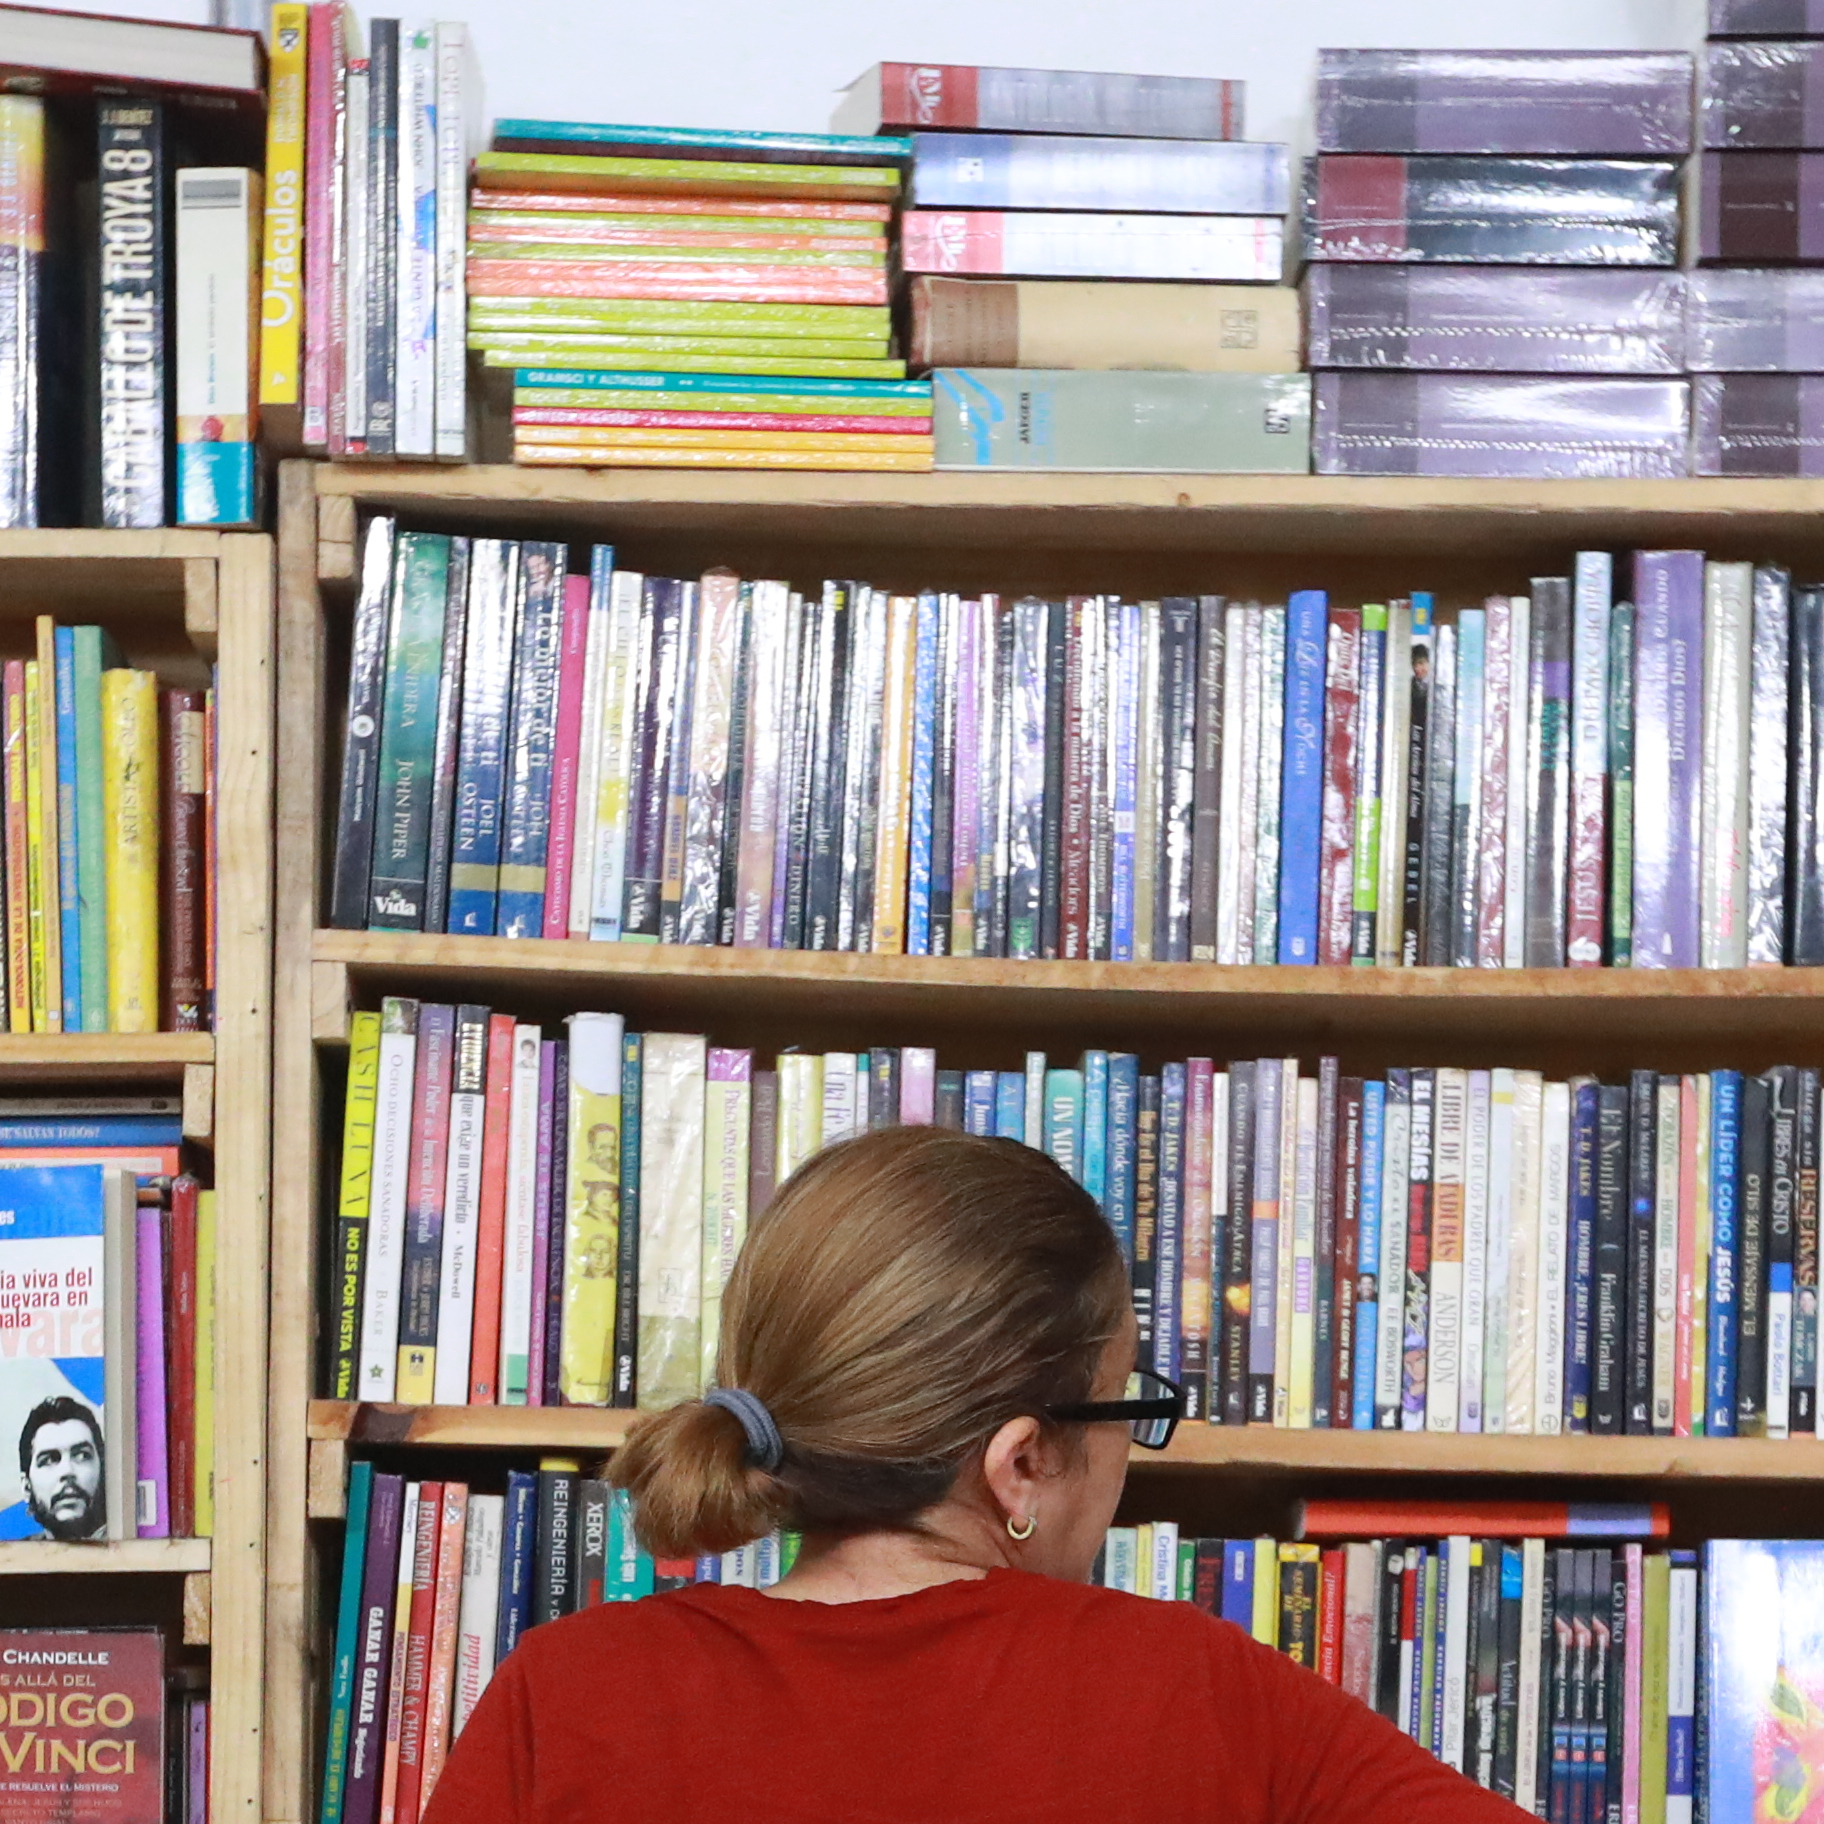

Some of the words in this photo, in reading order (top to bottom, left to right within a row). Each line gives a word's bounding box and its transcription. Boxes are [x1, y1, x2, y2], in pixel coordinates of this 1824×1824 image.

[262, 171, 295, 328] Oráculos
[1412, 1080, 1431, 1102] EL
[1411, 1105, 1434, 1179] MESÍAS
[1718, 1120, 1737, 1177] LÍDER
[1717, 1183, 1734, 1241] COMO
[1746, 1174, 1760, 1211] SILO
[345, 1227, 360, 1250] NO
[1746, 1216, 1759, 1236] DE
[1798, 1169, 1816, 1286] RESERVAS
[23, 1270, 59, 1288] viva
[65, 1267, 93, 1287] del
[344, 1254, 359, 1272] ES
[1715, 1247, 1735, 1303] JESÚS
[1744, 1241, 1760, 1312] MENSAJE
[67, 1291, 88, 1306] en
[342, 1274, 357, 1306] POR
[340, 1308, 355, 1352] VISTA
[1744, 1316, 1756, 1336] EL
[586, 1502, 603, 1556] XEROX
[365, 1607, 384, 1662] GANAR
[4, 1650, 109, 1665] CHANDELLE
[62, 1673, 96, 1687] DEL
[359, 1668, 380, 1723] GANAR
